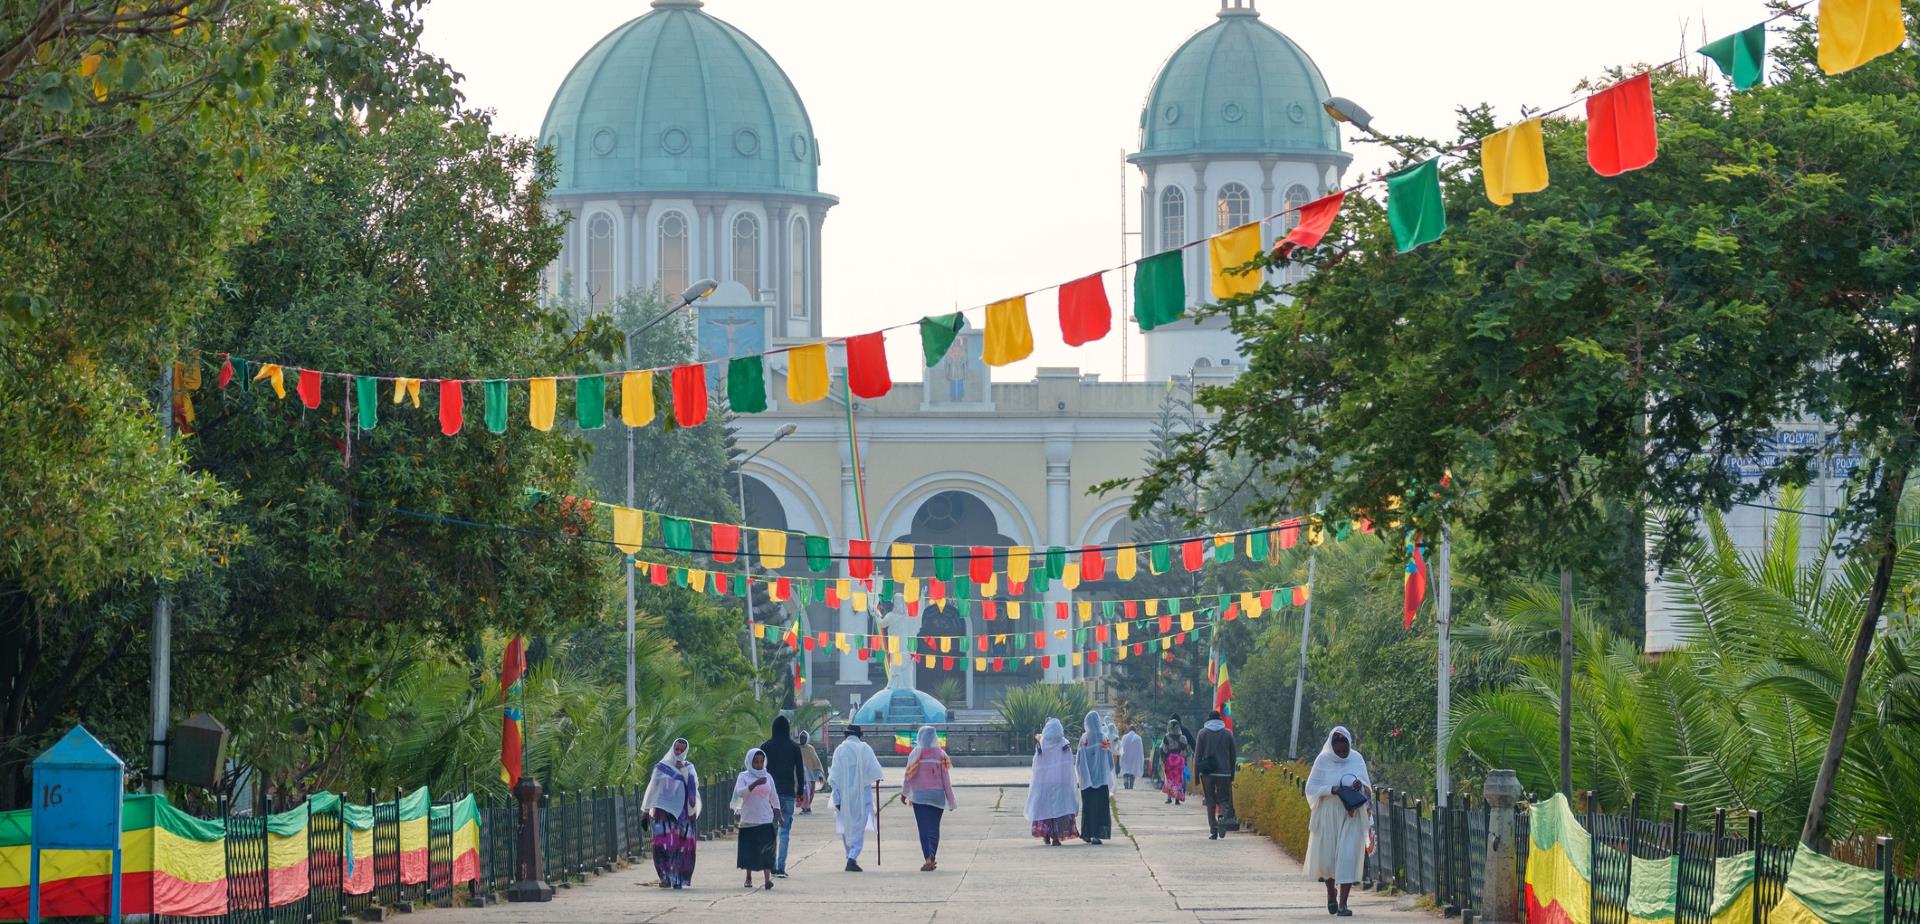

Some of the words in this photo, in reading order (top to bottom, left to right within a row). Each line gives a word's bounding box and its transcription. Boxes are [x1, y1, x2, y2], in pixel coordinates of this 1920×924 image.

[1783, 432, 1819, 444] POLYTAN
[1731, 456, 1776, 468] POLYNK
[43, 784, 62, 810] 16
